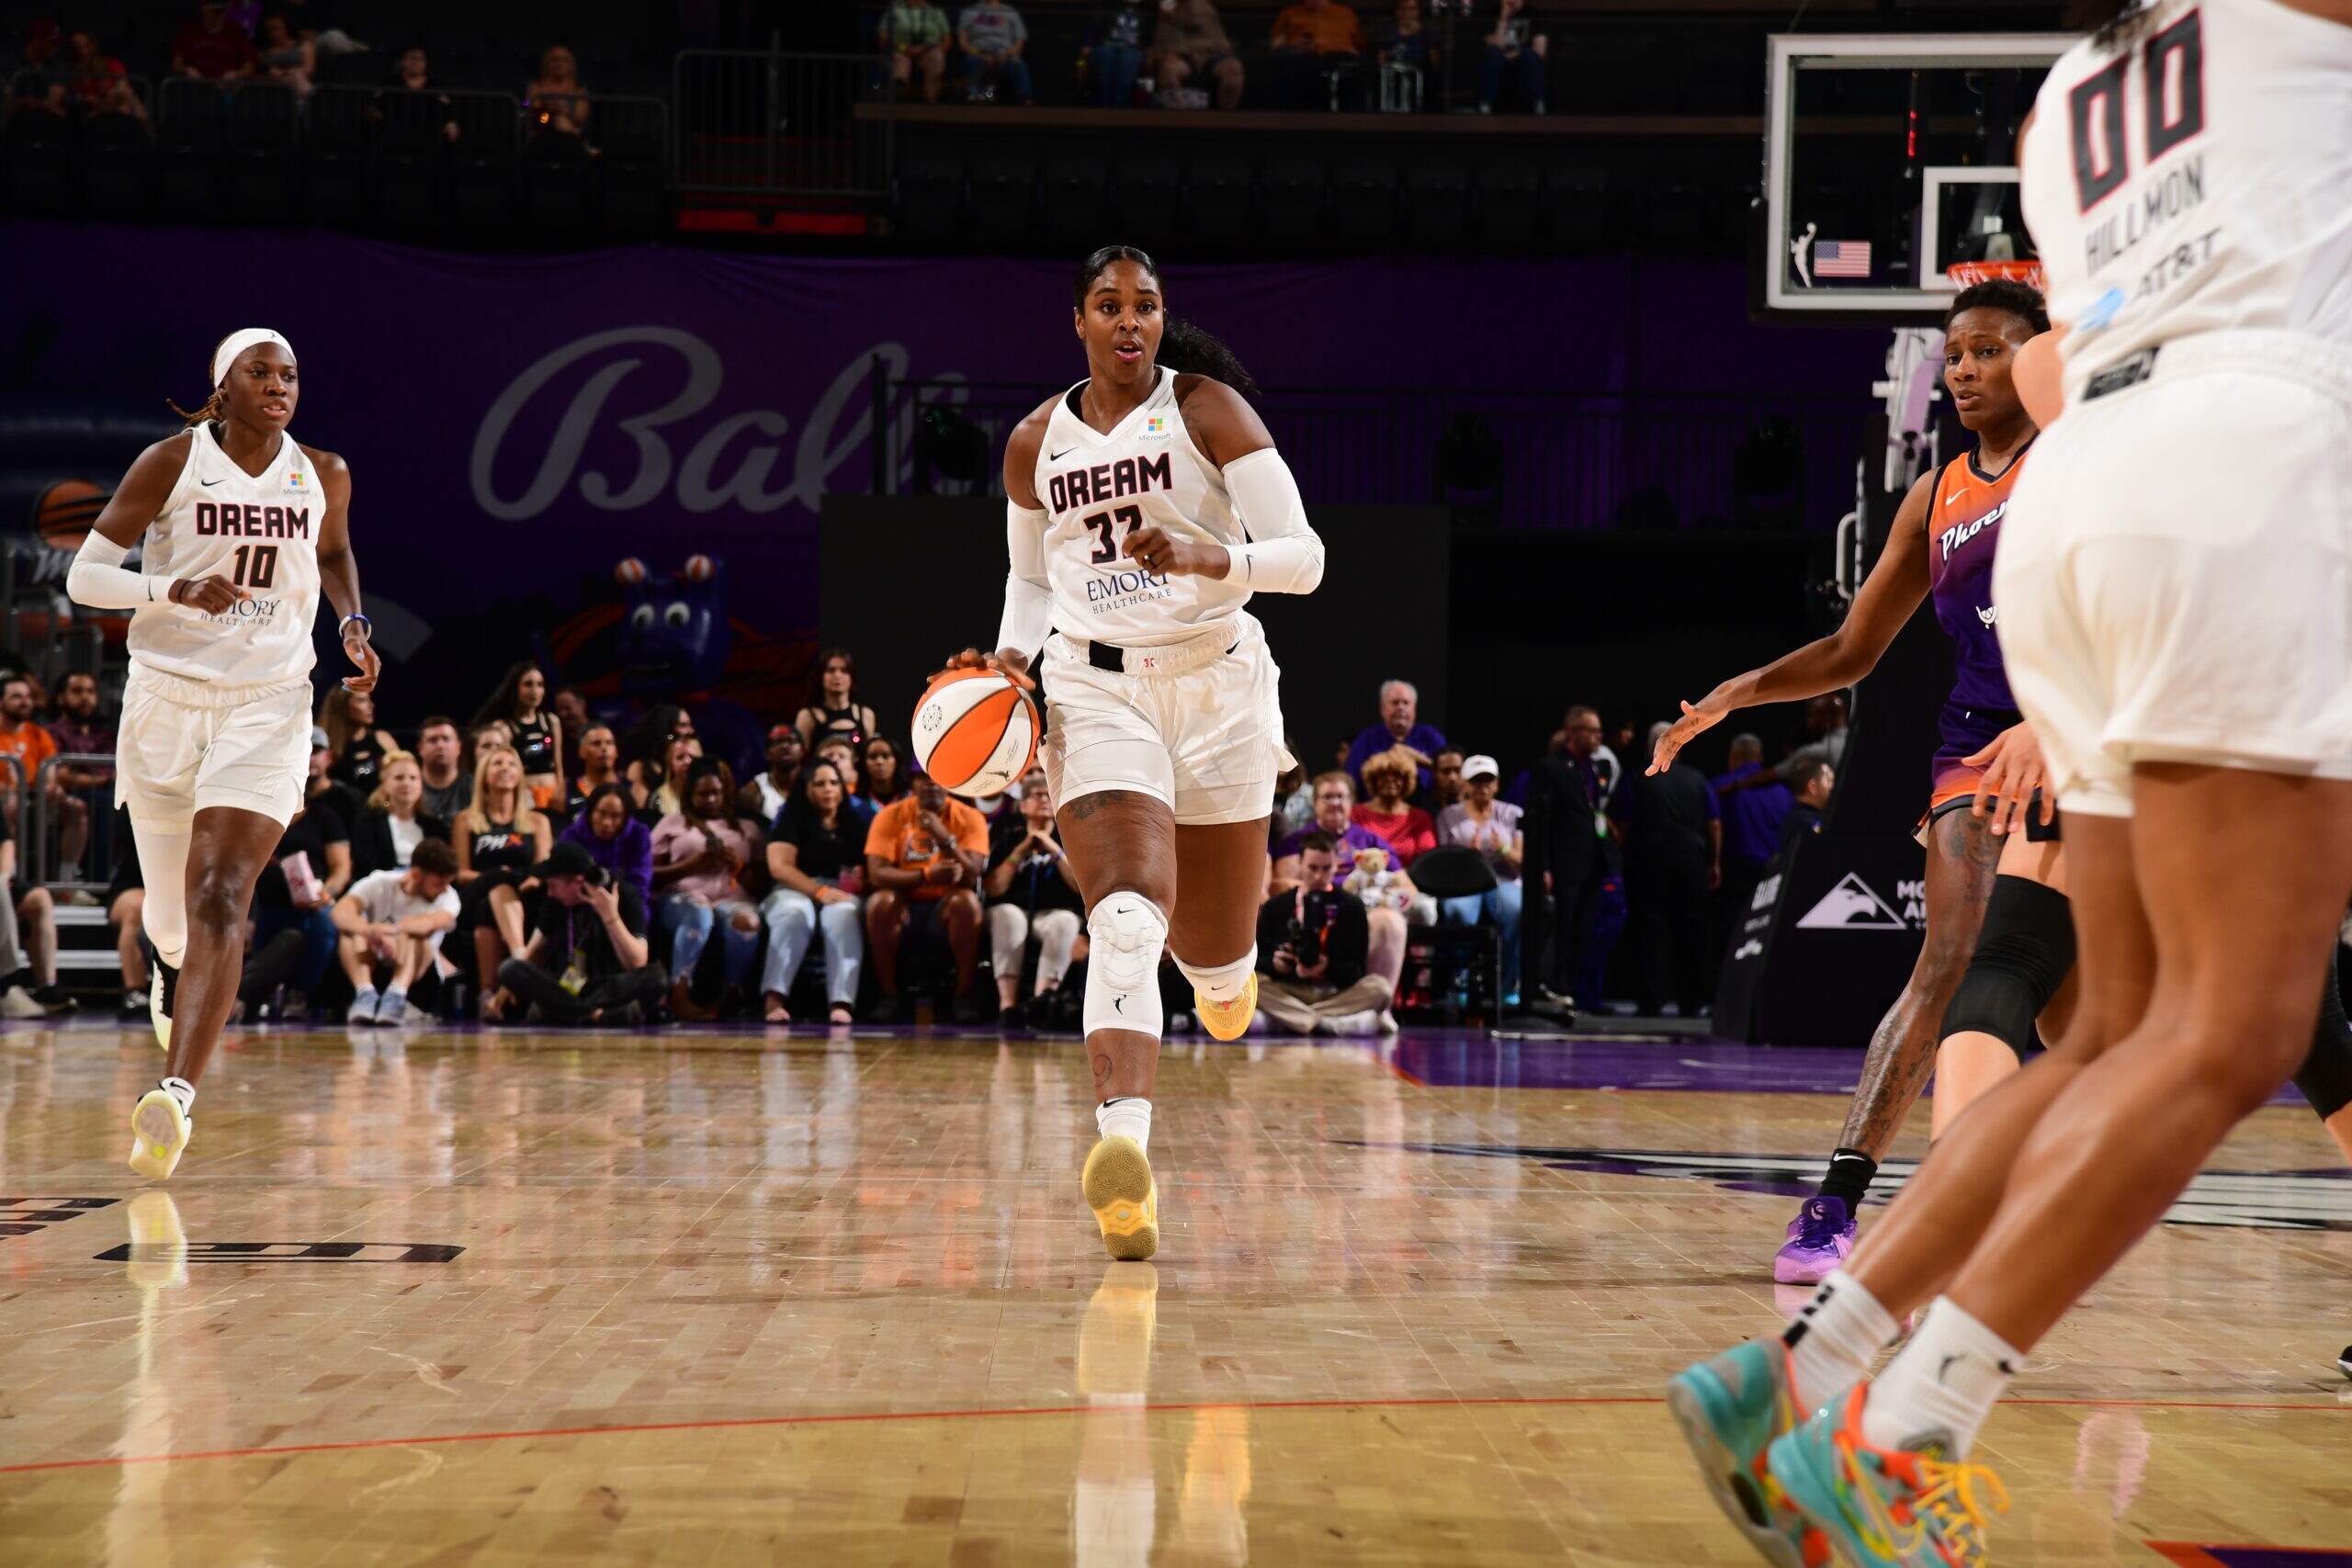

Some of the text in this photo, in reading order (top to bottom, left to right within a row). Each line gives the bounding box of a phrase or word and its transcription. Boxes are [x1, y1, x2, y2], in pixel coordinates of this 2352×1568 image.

[2067, 4, 2207, 217] 00
[2085, 154, 2206, 279] HILLMON
[1138, 432, 1171, 441] Microsoft
[1048, 452, 1173, 515] DREAM
[196, 502, 309, 540] DREAM
[233, 545, 278, 589] 10
[1091, 588, 1172, 615] HEALTHCARE
